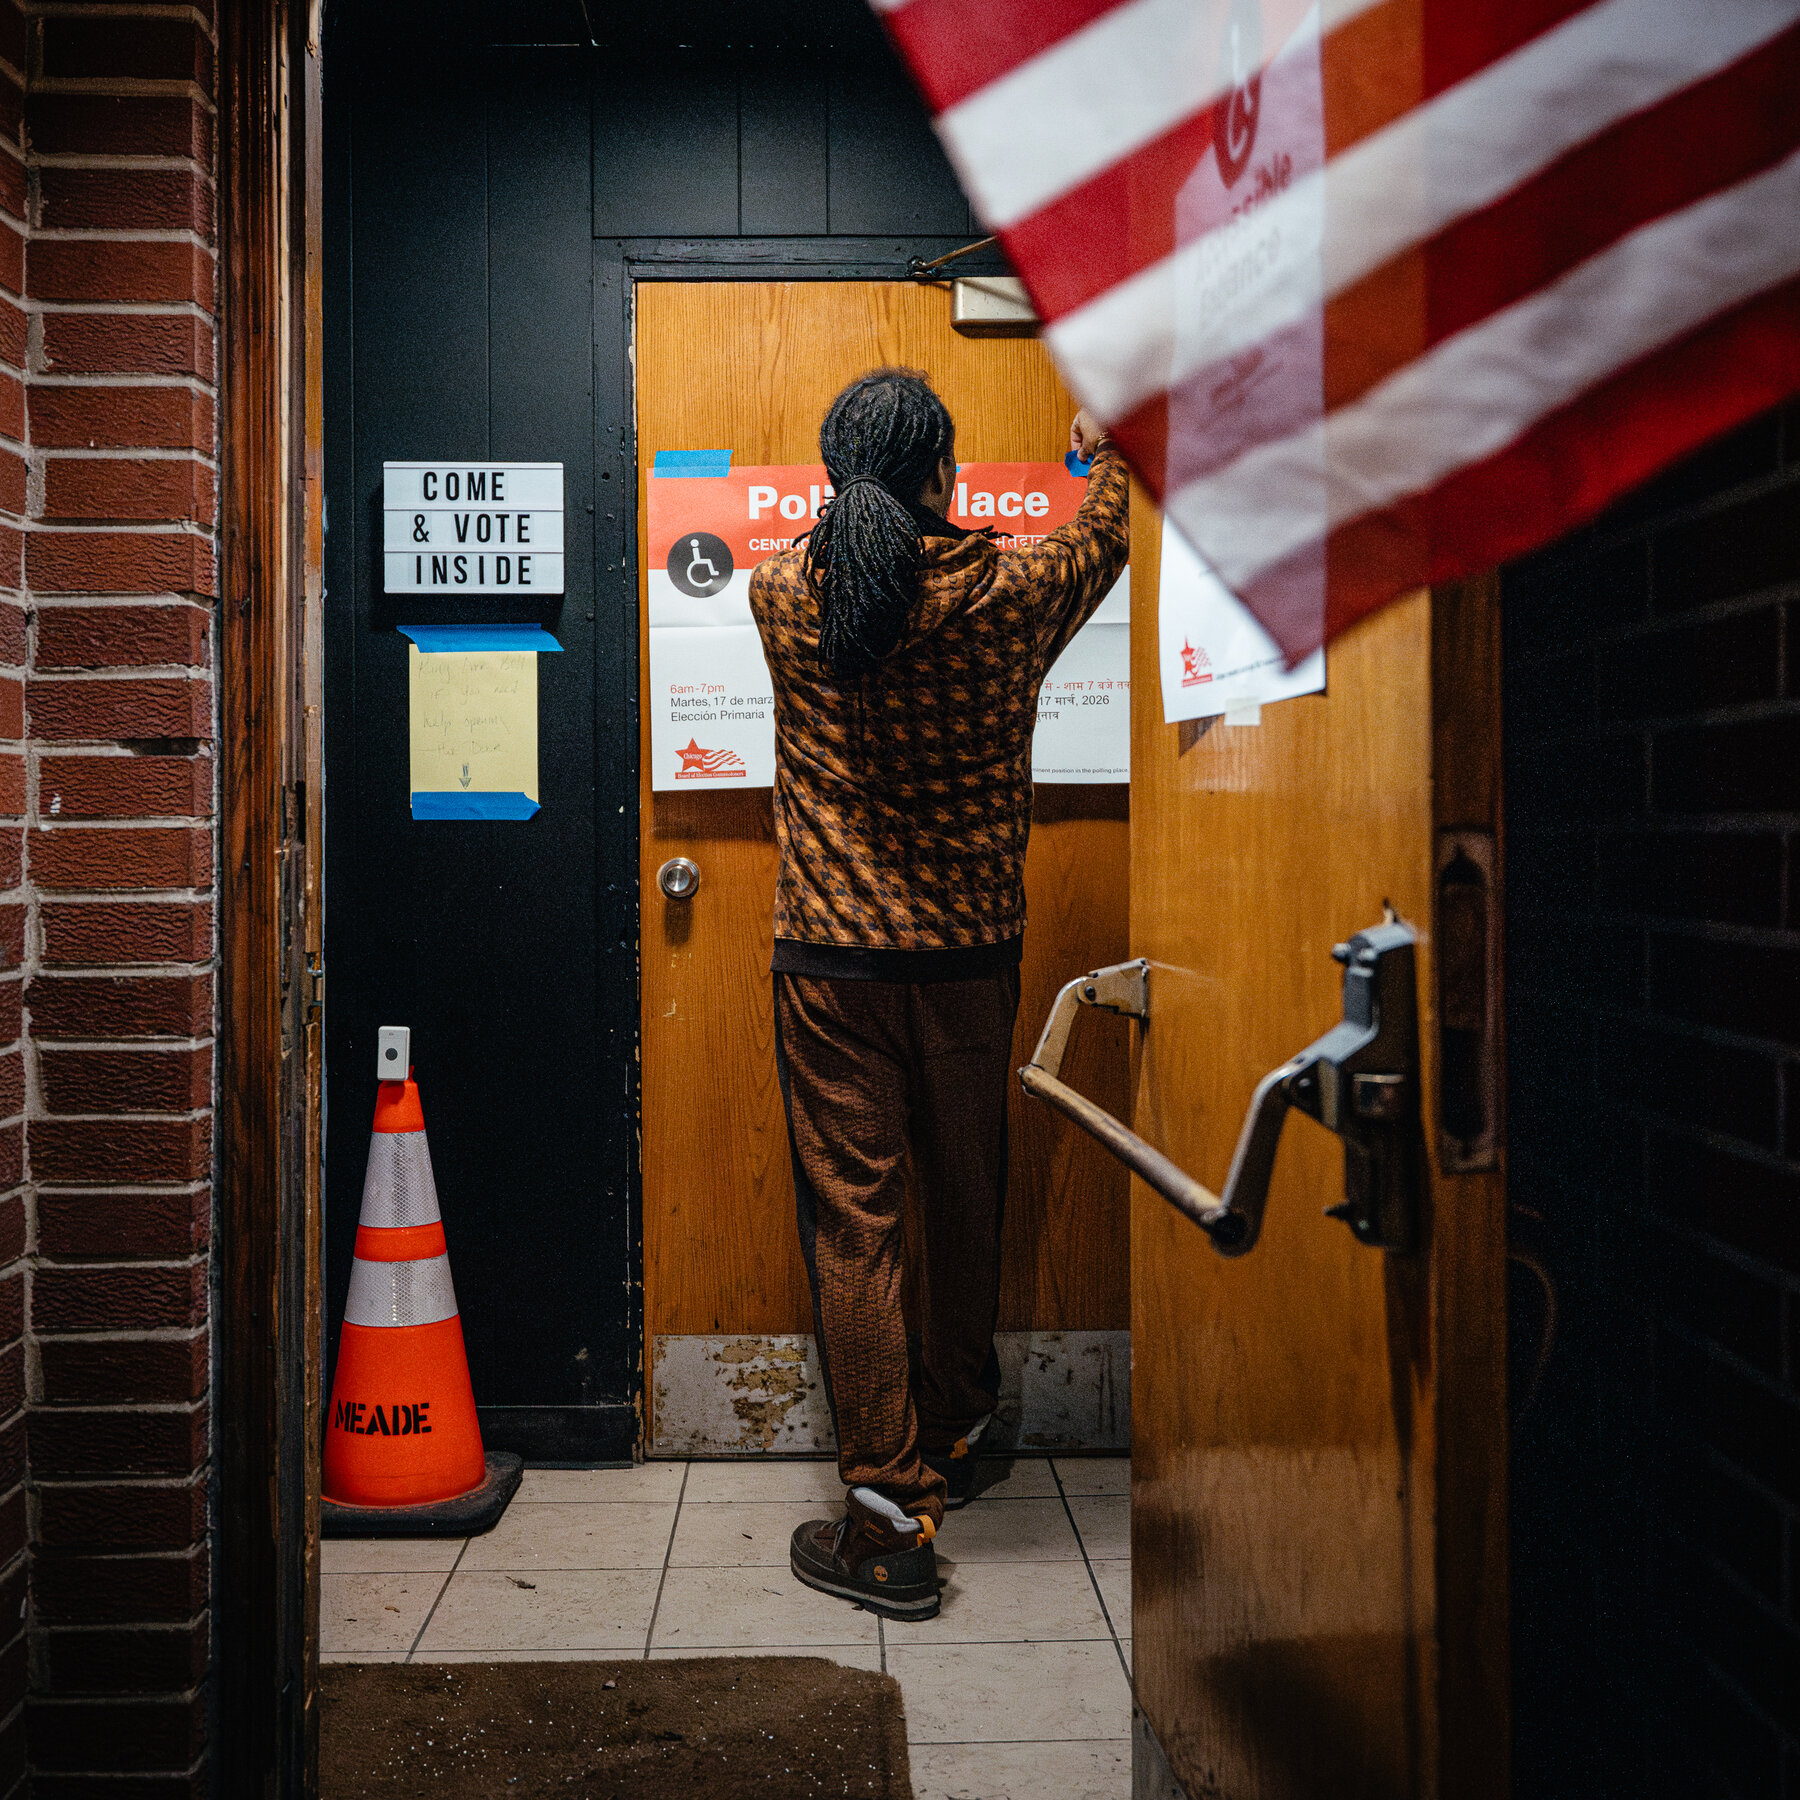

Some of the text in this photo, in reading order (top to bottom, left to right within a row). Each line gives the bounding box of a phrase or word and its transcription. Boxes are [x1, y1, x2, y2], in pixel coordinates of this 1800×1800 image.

[423, 471, 505, 501] COME
[748, 482, 1050, 520] Poll lace
[412, 513, 531, 543] & VOTE
[416, 555, 532, 585] INSIDE
[1039, 696, 1051, 706] 17
[1081, 695, 1110, 705] 2026
[1087, 680, 1094, 691] 7
[670, 695, 773, 708] Martes, 17 de marz
[671, 709, 765, 722] Elección Primaria
[334, 1398, 432, 1436] MEADE
